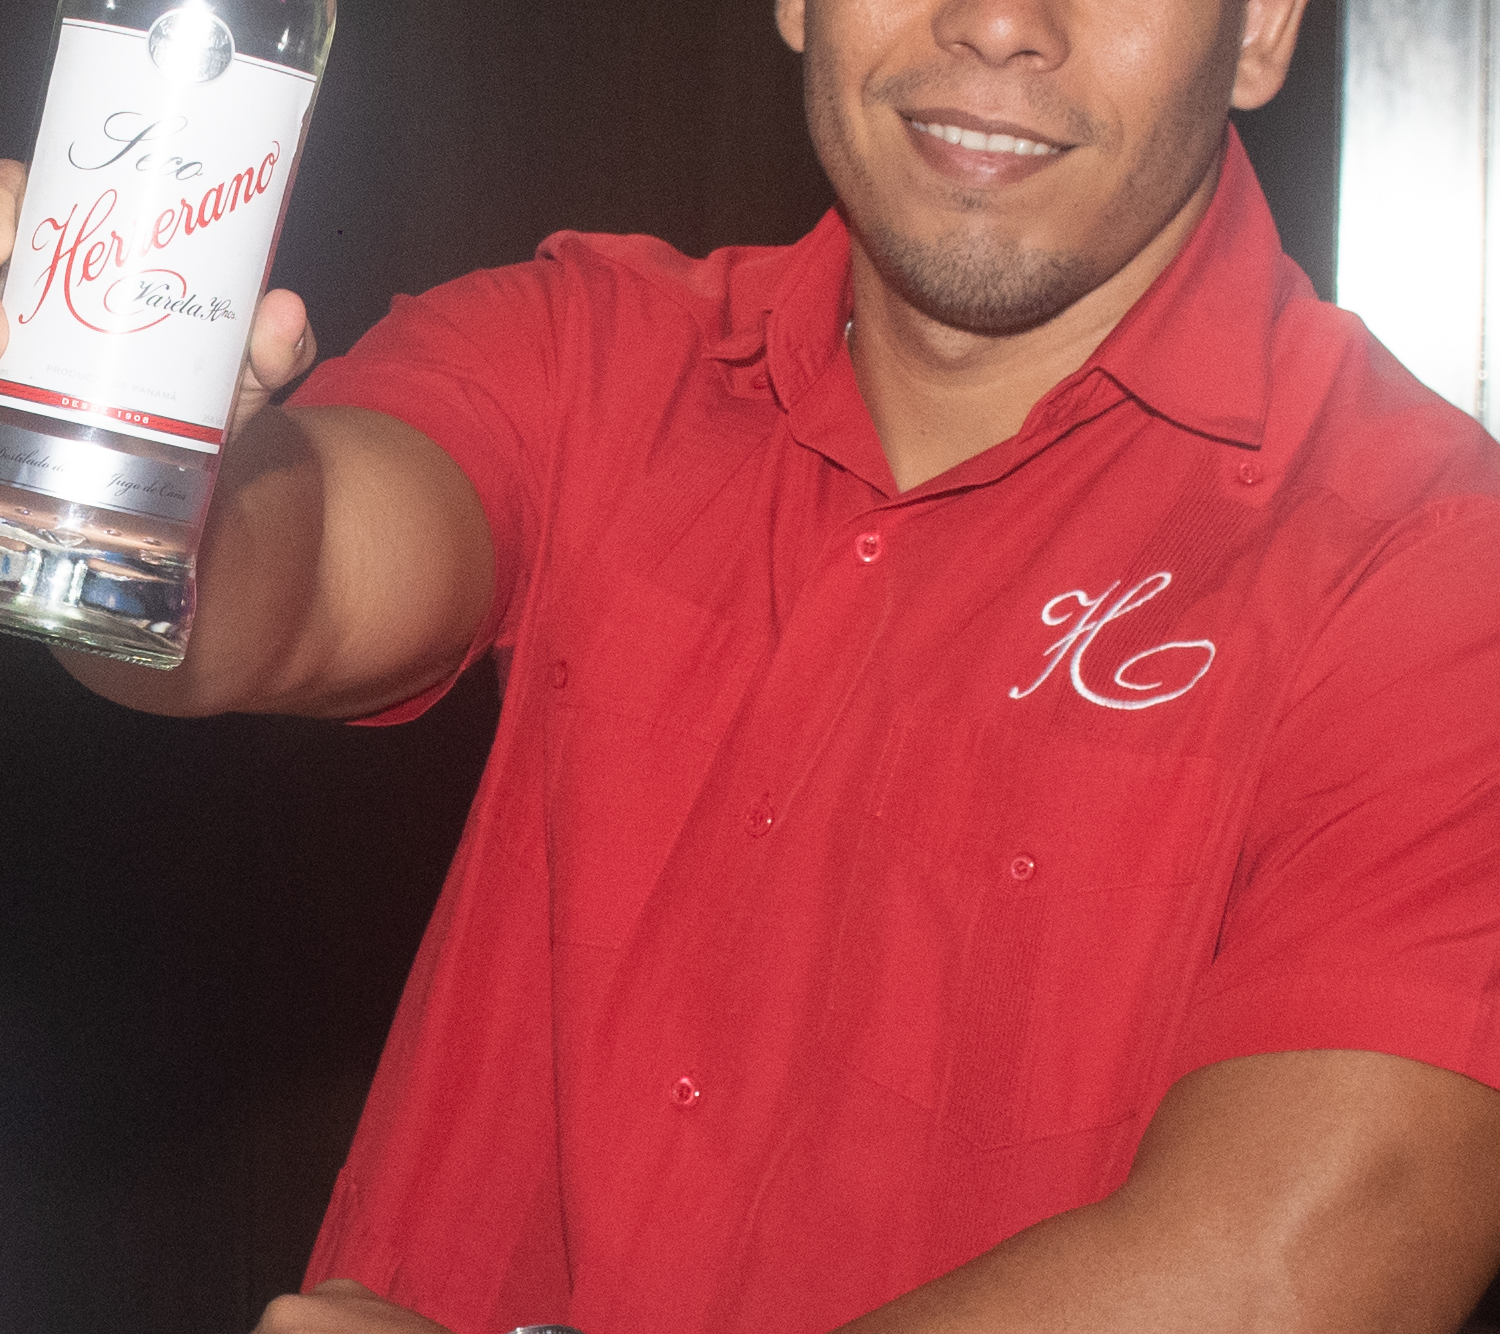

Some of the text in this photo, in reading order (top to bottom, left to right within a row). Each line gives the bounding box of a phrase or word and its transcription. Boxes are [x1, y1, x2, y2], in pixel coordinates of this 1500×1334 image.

[68, 111, 204, 181] Seco
[18, 140, 281, 335] Herrerano
[132, 280, 203, 318] Varela
[46, 364, 104, 385] PRODUCT
[61, 397, 150, 425] DESDE 1908
[107, 473, 141, 504] Jugo
